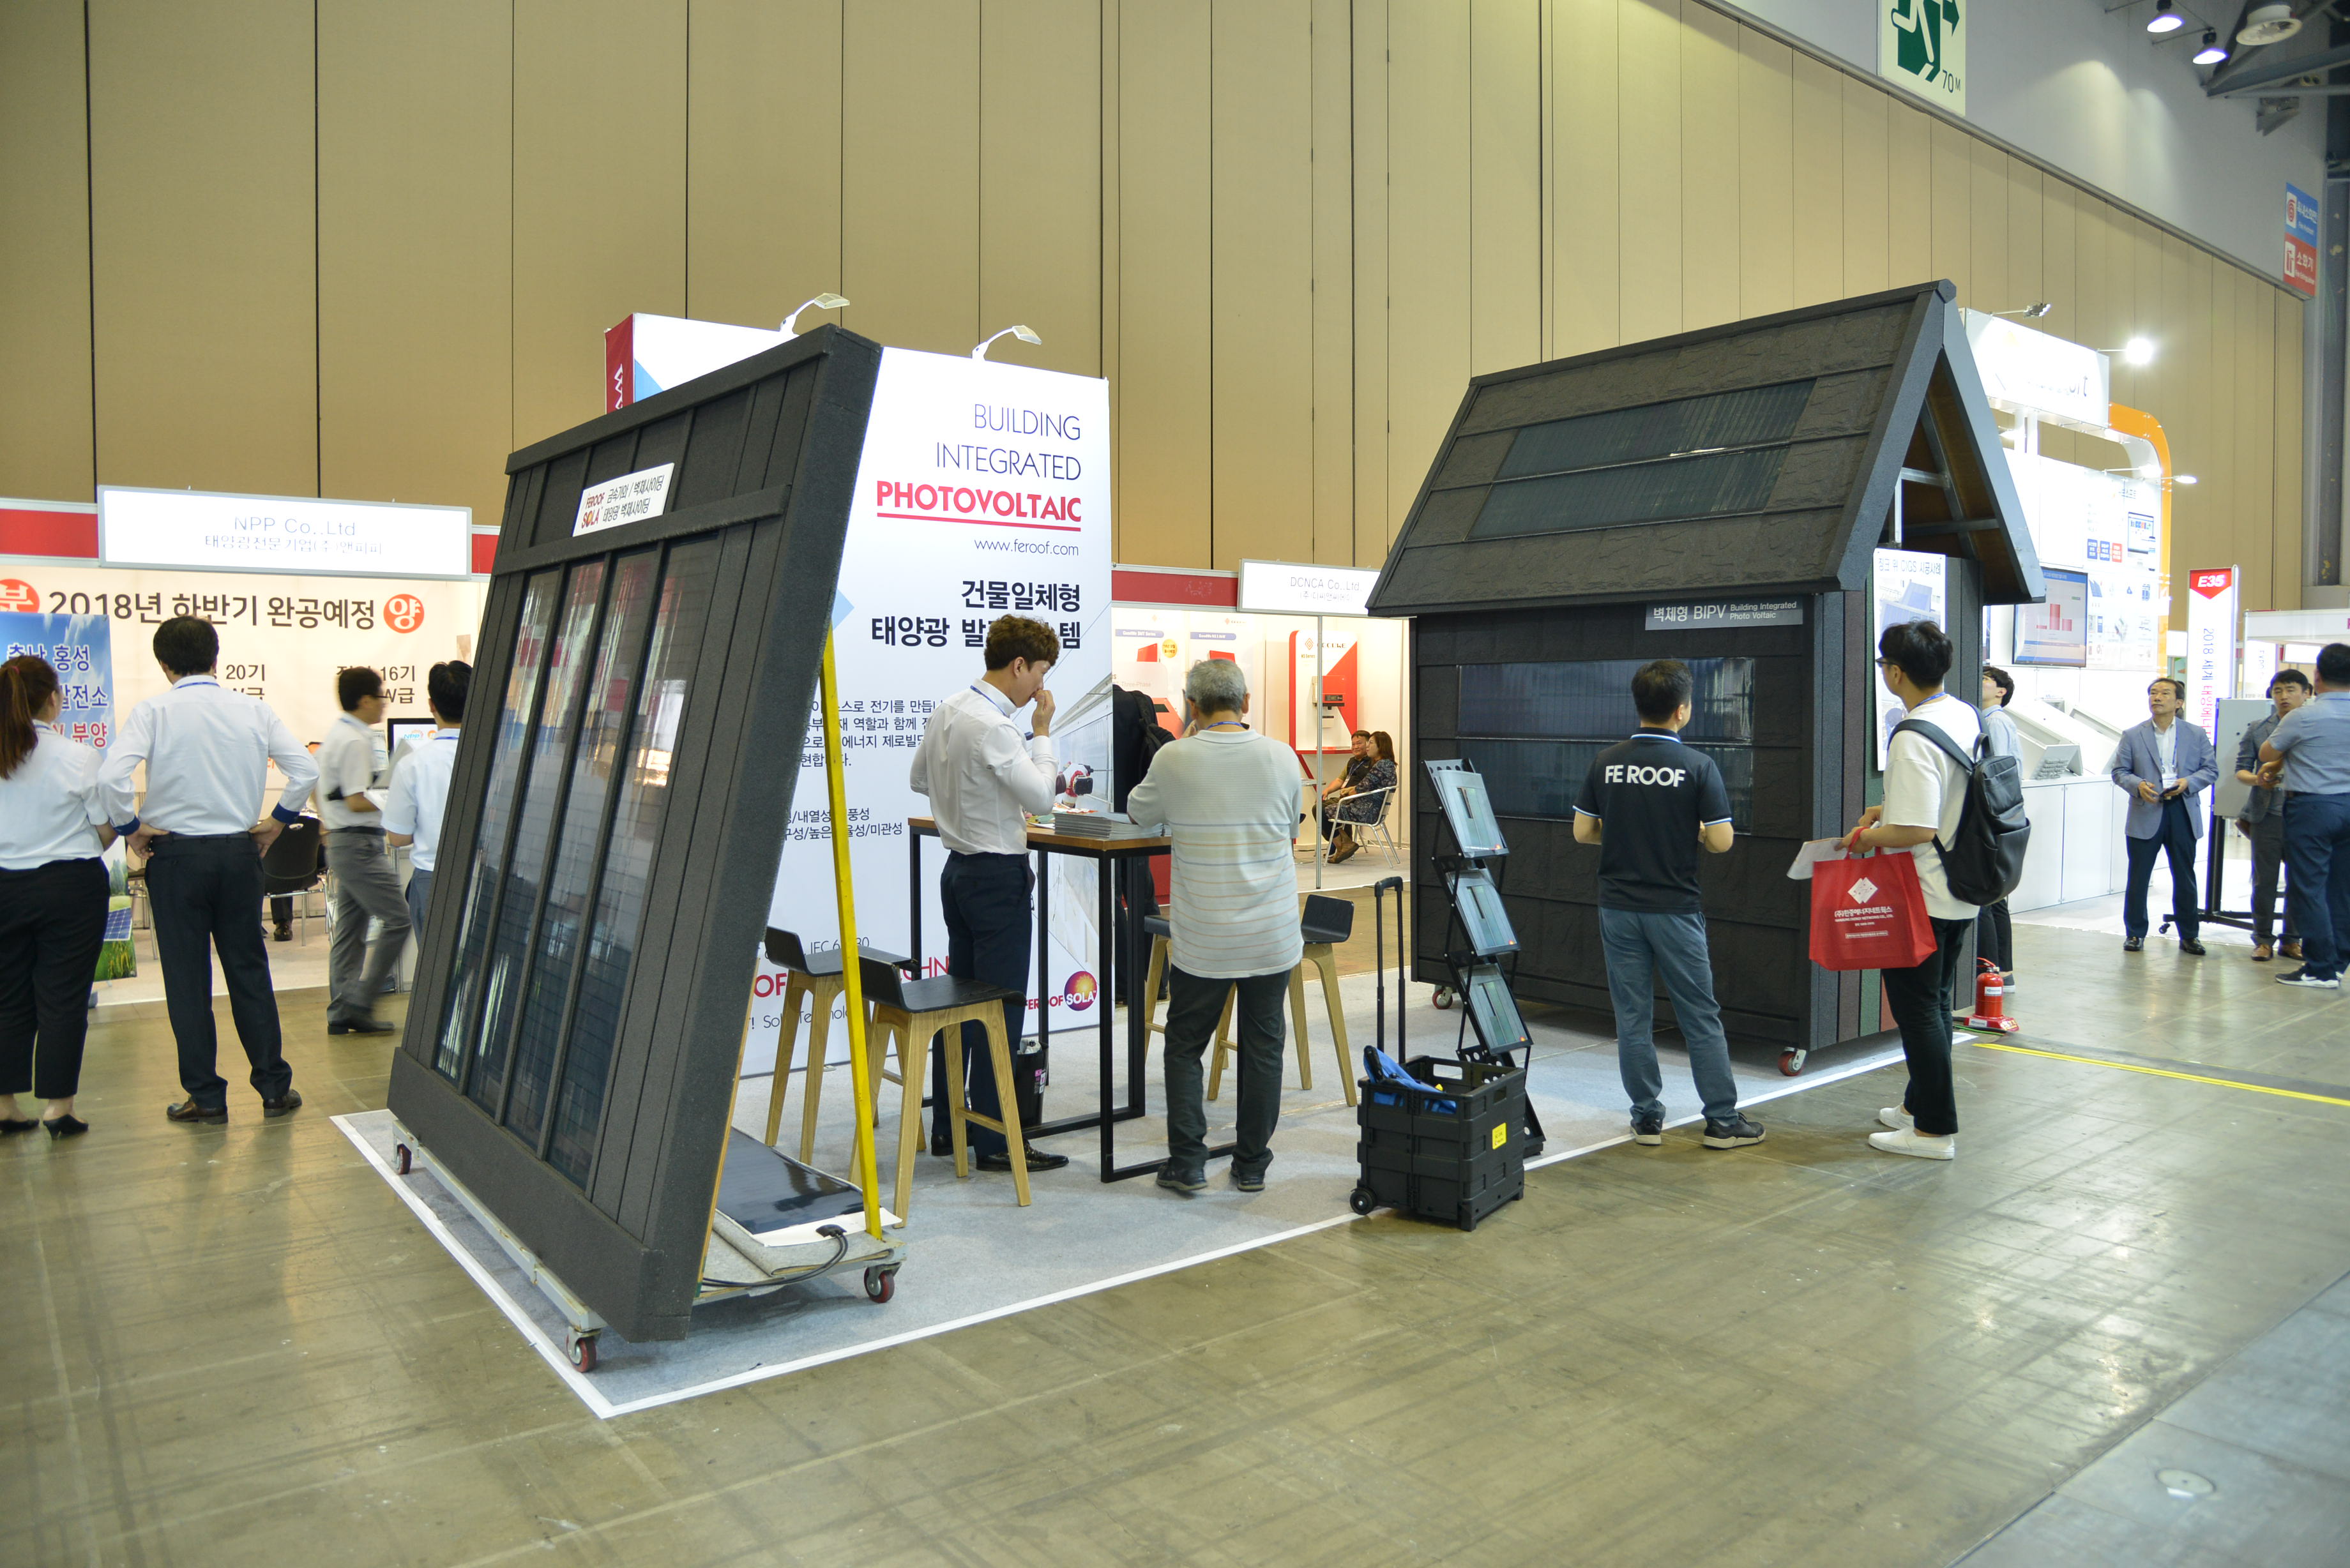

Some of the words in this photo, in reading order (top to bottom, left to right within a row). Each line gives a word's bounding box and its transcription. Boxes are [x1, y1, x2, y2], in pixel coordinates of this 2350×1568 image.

[974, 403, 1080, 441] BUILDING
[937, 442, 1081, 480] INTEGRATED
[877, 480, 1081, 522] PHOTOVOLTAIC
[234, 516, 275, 531] NPP
[974, 539, 1079, 555] www.feroof.com
[2197, 575, 2225, 587] E35
[961, 580, 1081, 612] 건물일체형
[49, 591, 162, 624] 2018년
[172, 592, 257, 626] 하반기
[267, 596, 375, 629] 완공예정
[388, 598, 421, 629] 양
[1653, 606, 1688, 622] 벽체형
[1693, 605, 1727, 619] BIPV
[1730, 603, 1758, 612] Building
[1759, 601, 1797, 611] Integrated
[1729, 612, 1750, 621] Photo
[871, 615, 950, 647] 태양광
[2203, 628, 2215, 654] 2018
[53, 644, 90, 672] 홍성
[226, 664, 266, 681] 20기
[380, 665, 416, 682] 16기
[870, 700, 906, 713] 전기를
[853, 717, 889, 731] 역할과
[894, 716, 917, 731] 함께
[842, 735, 877, 749] 에너지
